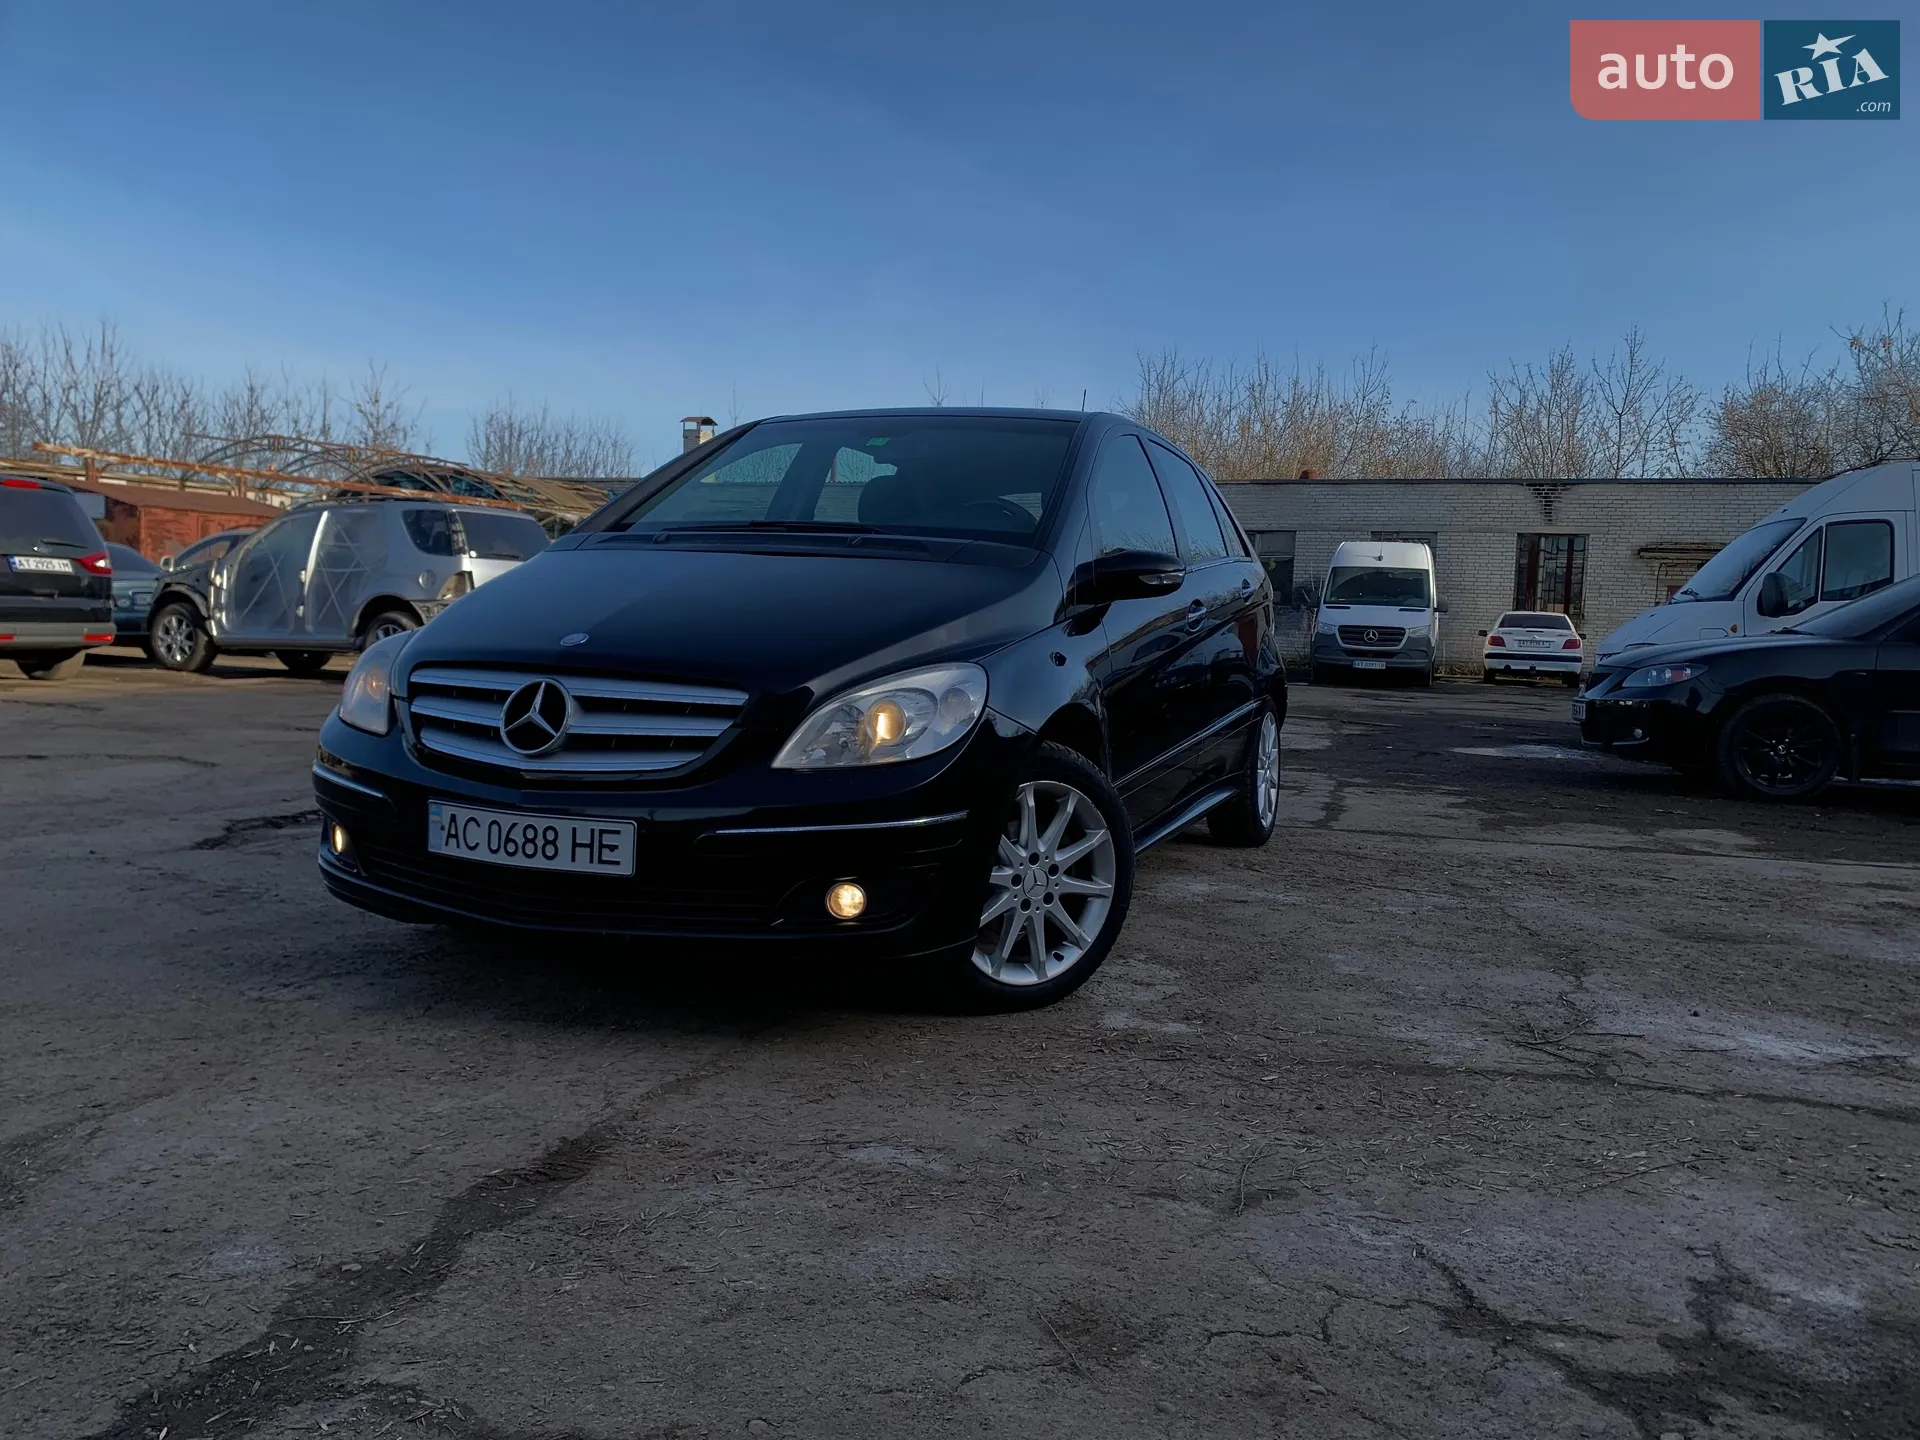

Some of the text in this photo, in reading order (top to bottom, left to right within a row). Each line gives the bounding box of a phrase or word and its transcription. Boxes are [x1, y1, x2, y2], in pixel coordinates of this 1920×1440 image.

[444, 813, 621, 866] AC 0688 HE
